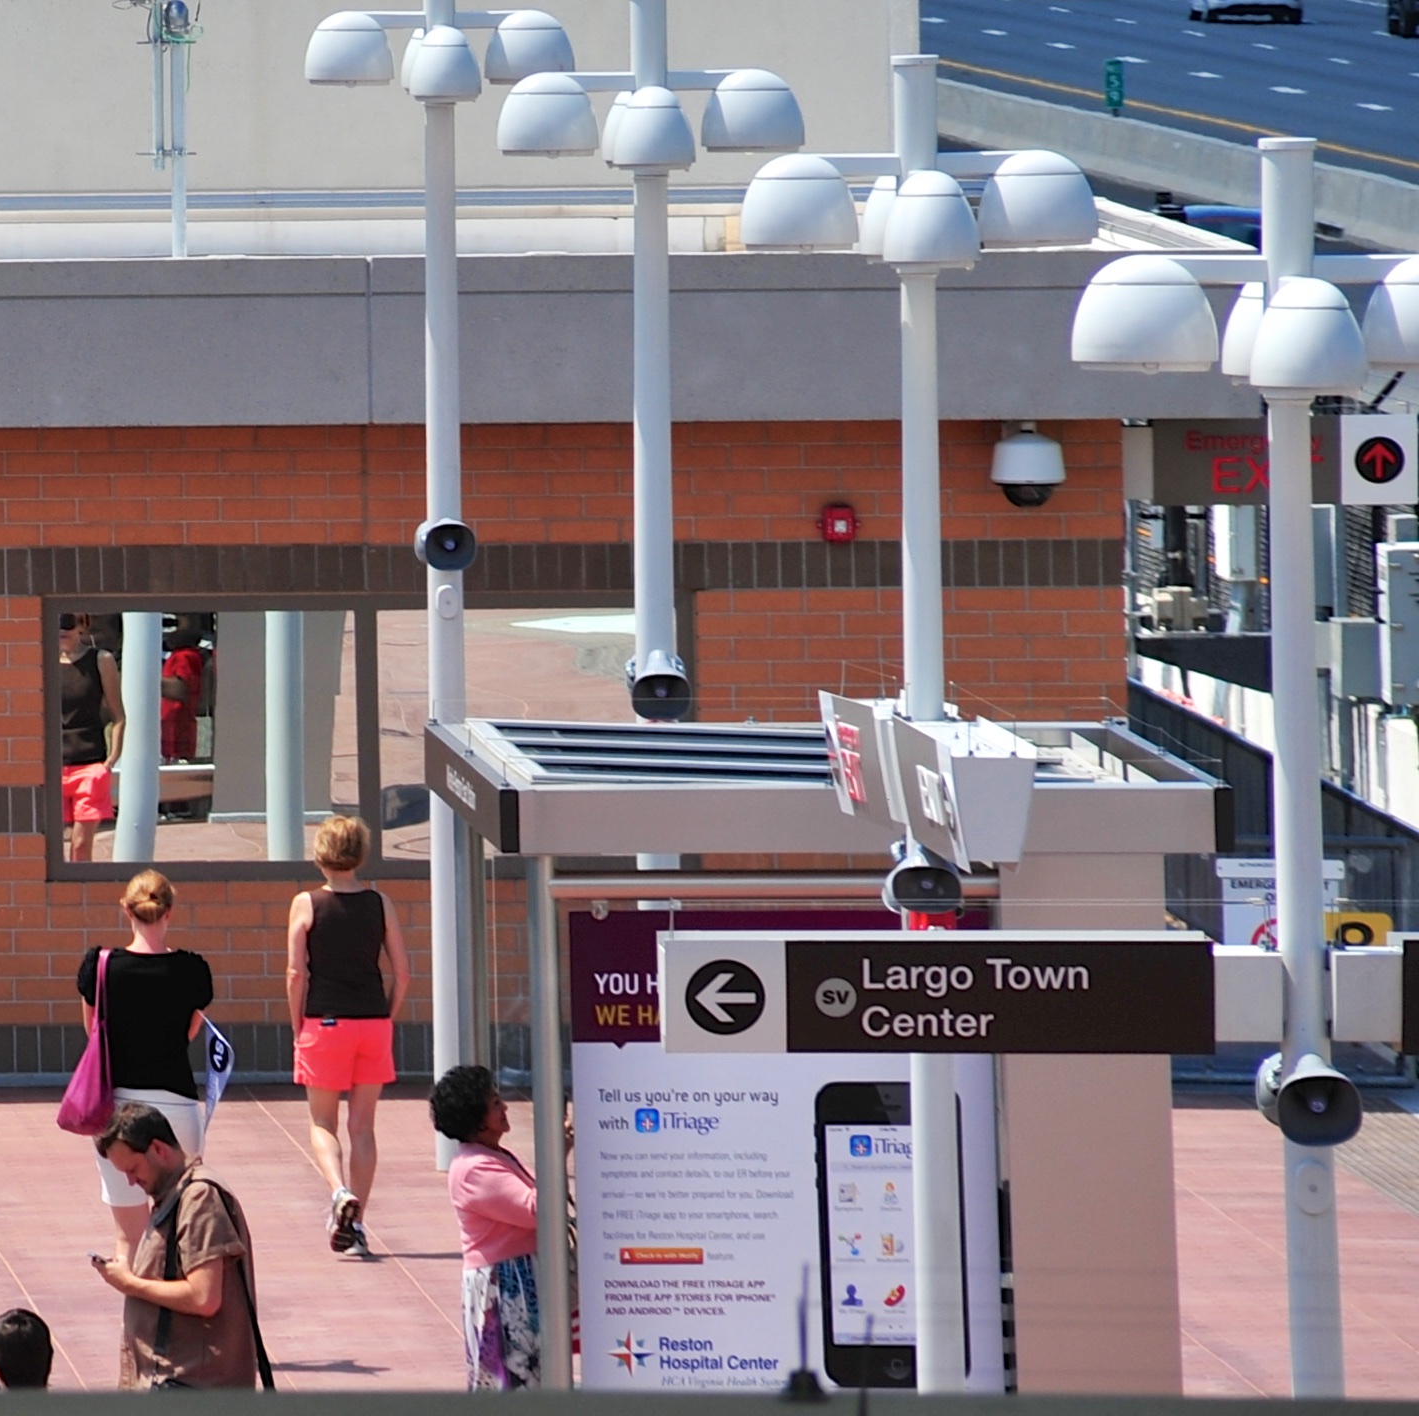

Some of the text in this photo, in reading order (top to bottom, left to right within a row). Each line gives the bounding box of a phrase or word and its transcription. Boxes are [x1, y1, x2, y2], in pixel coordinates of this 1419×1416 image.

[1186, 431, 1322, 452] Emergy
[1231, 879, 1276, 890] EMERG
[862, 957, 1090, 996] Largo Town
[594, 973, 640, 995] YOU
[822, 990, 849, 1005] SV
[594, 1005, 630, 1026] WE
[862, 1005, 994, 1038] Center
[598, 1089, 779, 1106] Tell us you're on your way
[599, 1112, 719, 1135] with iTriage
[874, 1138, 913, 1160] iTriag
[600, 1152, 618, 1160] Now
[620, 1153, 633, 1161] you
[650, 1152, 668, 1160] send
[670, 1153, 685, 1161] your
[734, 1152, 767, 1161] including
[601, 1171, 638, 1179] symptoms
[640, 1170, 654, 1178] and
[737, 1170, 747, 1178] ER
[749, 1170, 773, 1178] before
[775, 1172, 790, 1180] your
[668, 1190, 690, 1199] better
[692, 1190, 725, 1201] prepared
[727, 1190, 736, 1199] for
[756, 1190, 794, 1199] Download
[602, 1210, 614, 1219] the
[616, 1210, 634, 1219] FREE
[636, 1210, 661, 1221] iTriage
[663, 1213, 676, 1221] app
[679, 1211, 686, 1219] to
[688, 1213, 703, 1221] your
[754, 1210, 778, 1219] search
[636, 1231, 646, 1240] for
[649, 1231, 674, 1240] Reston
[676, 1231, 707, 1242] Hospital
[736, 1231, 750, 1240] and
[604, 1280, 765, 1288] DOWNLOAD THE FREE ITRIAGE APP
[605, 1293, 633, 1302] FROM
[634, 1293, 652, 1302] THE
[654, 1293, 673, 1302] APP
[675, 1293, 712, 1302] STORES
[714, 1293, 733, 1302] FOR
[606, 1307, 626, 1315] AND
[684, 1307, 726, 1315] DEVICES.
[659, 1337, 713, 1351] Reston
[659, 1355, 779, 1372] Hospital Center
[690, 1376, 724, 1388] Virginia
[726, 1376, 757, 1386] Health
[761, 1376, 790, 1389] Syste
